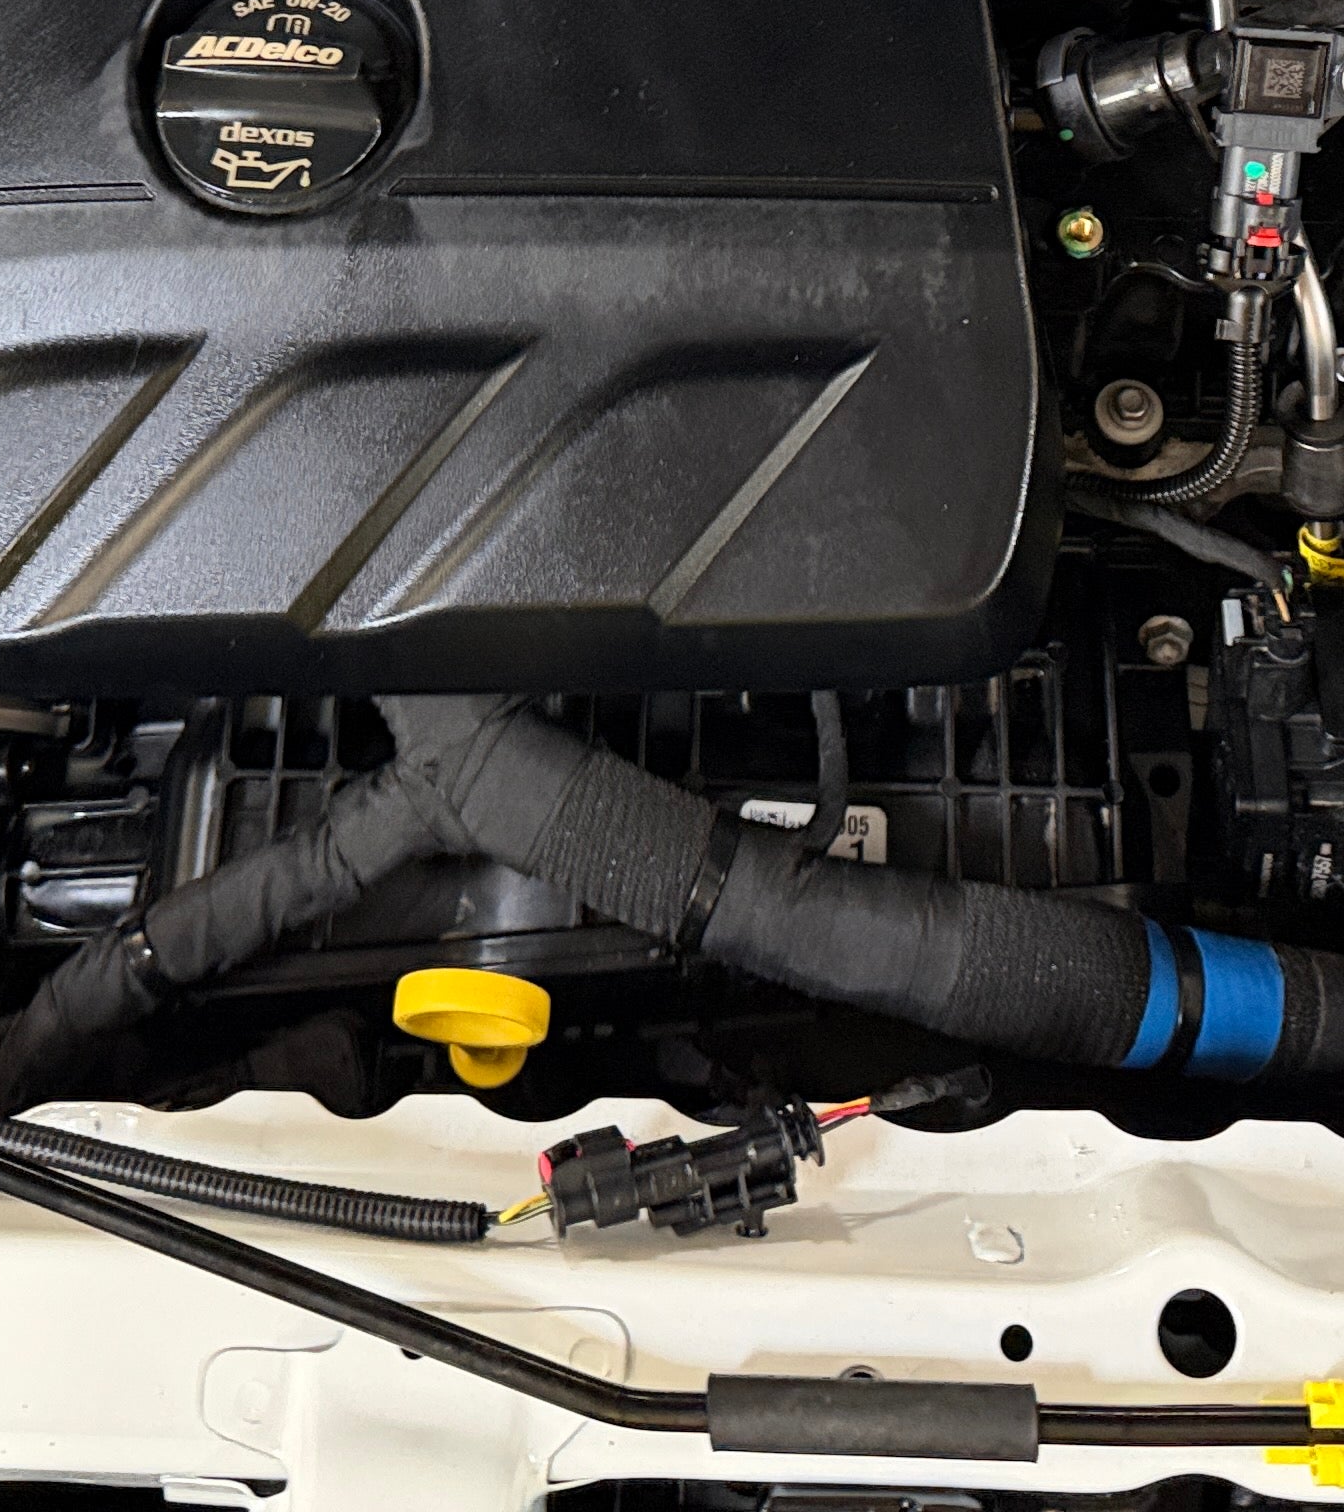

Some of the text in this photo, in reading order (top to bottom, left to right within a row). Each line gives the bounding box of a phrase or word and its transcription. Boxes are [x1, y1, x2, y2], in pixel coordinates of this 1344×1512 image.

[184, 35, 345, 65] ACDelco
[219, 122, 315, 148] dexos
[840, 814, 870, 836] 05
